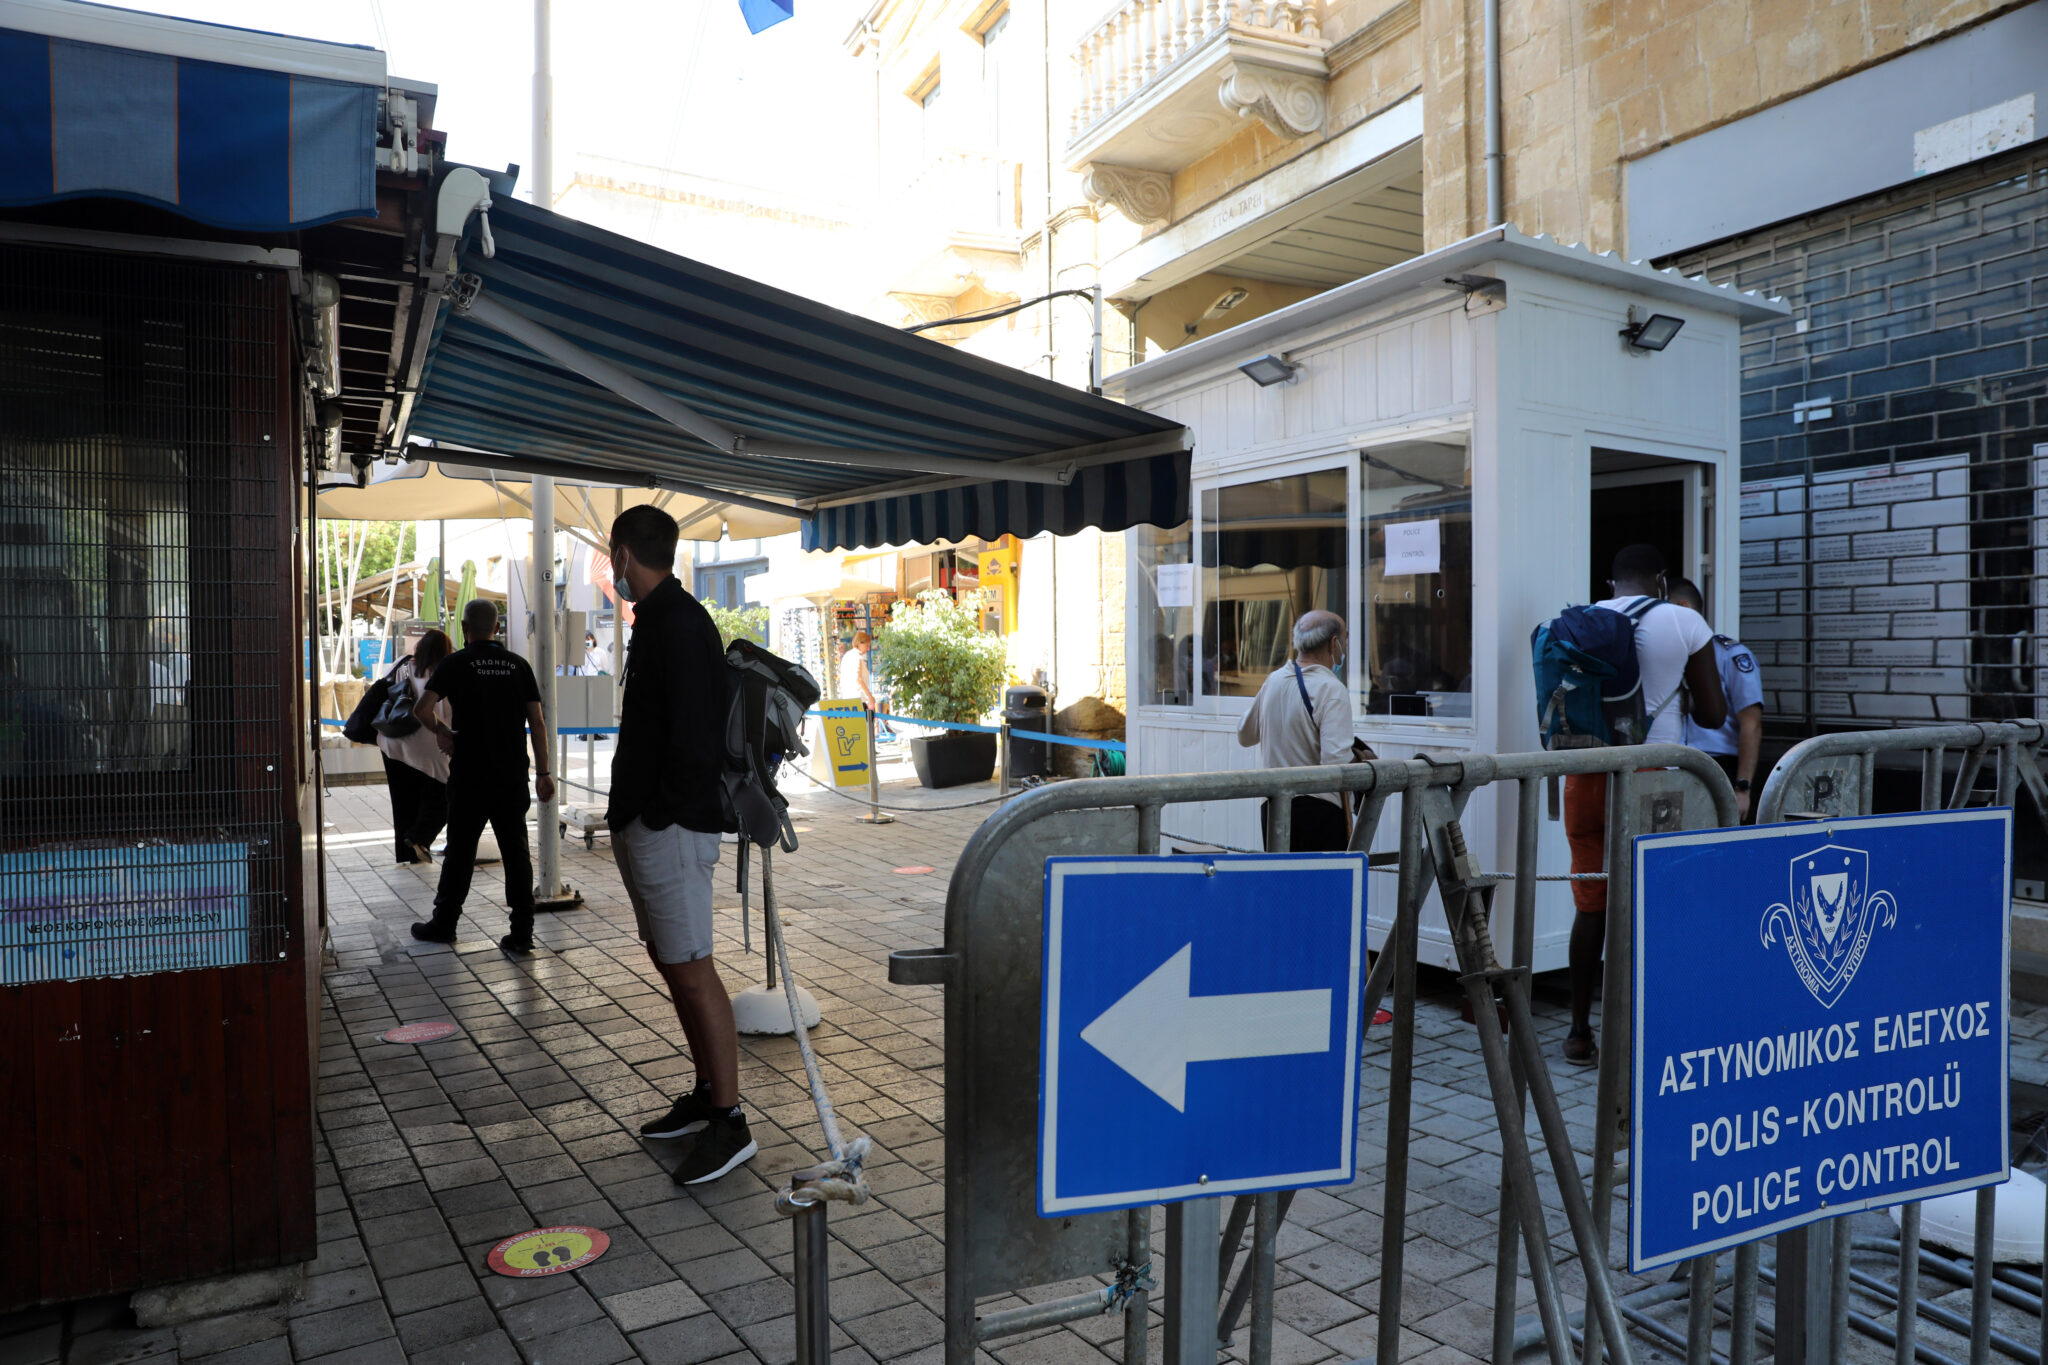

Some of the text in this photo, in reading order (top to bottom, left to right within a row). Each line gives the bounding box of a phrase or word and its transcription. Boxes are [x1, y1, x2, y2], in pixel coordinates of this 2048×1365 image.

[1403, 528, 1421, 536] POLICE
[477, 668, 511, 676] CUSTOMS
[1786, 930, 1869, 995] ΑΣΤΥΝΟΜΙΑ ΚΥΠΡΟΥ
[1658, 1001, 1991, 1097] ΑΣΤΥΝΟΜΙΚΟΣ ΕΛΕΓΧΟΣ
[1690, 1061, 1962, 1162] POLIS-KONTROLÜ
[1692, 1136, 1960, 1231] POLICE CONTROL
[496, 1227, 563, 1253] ΠΕΡΙΜΕΝΕΤΕ
[520, 1252, 596, 1275] WAIT HERE
